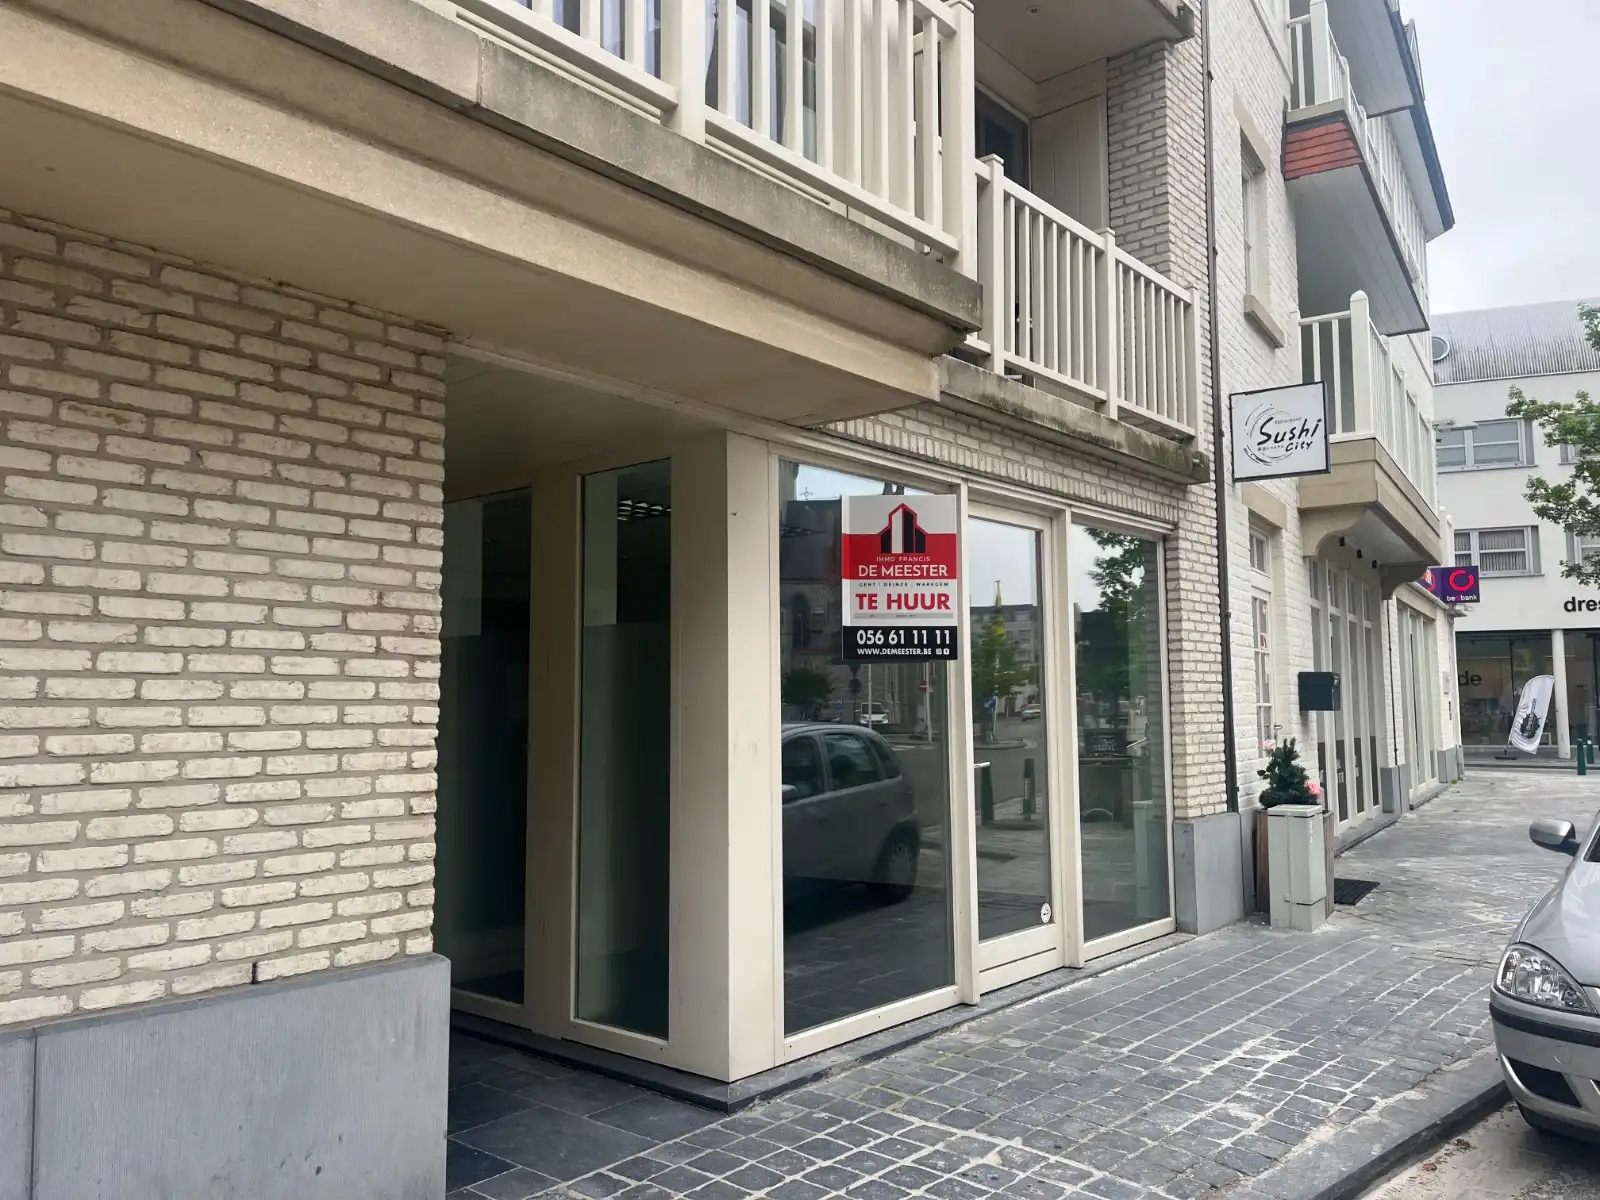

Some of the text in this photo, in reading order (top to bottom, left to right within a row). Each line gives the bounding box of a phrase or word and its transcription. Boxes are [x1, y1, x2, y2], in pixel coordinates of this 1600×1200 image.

[1257, 416, 1322, 446] Sushi
[858, 564, 948, 577] DE MEESTER
[855, 593, 951, 610] TE HUUR
[1563, 596, 1600, 613] dre
[856, 629, 950, 645] 056 61 11 11
